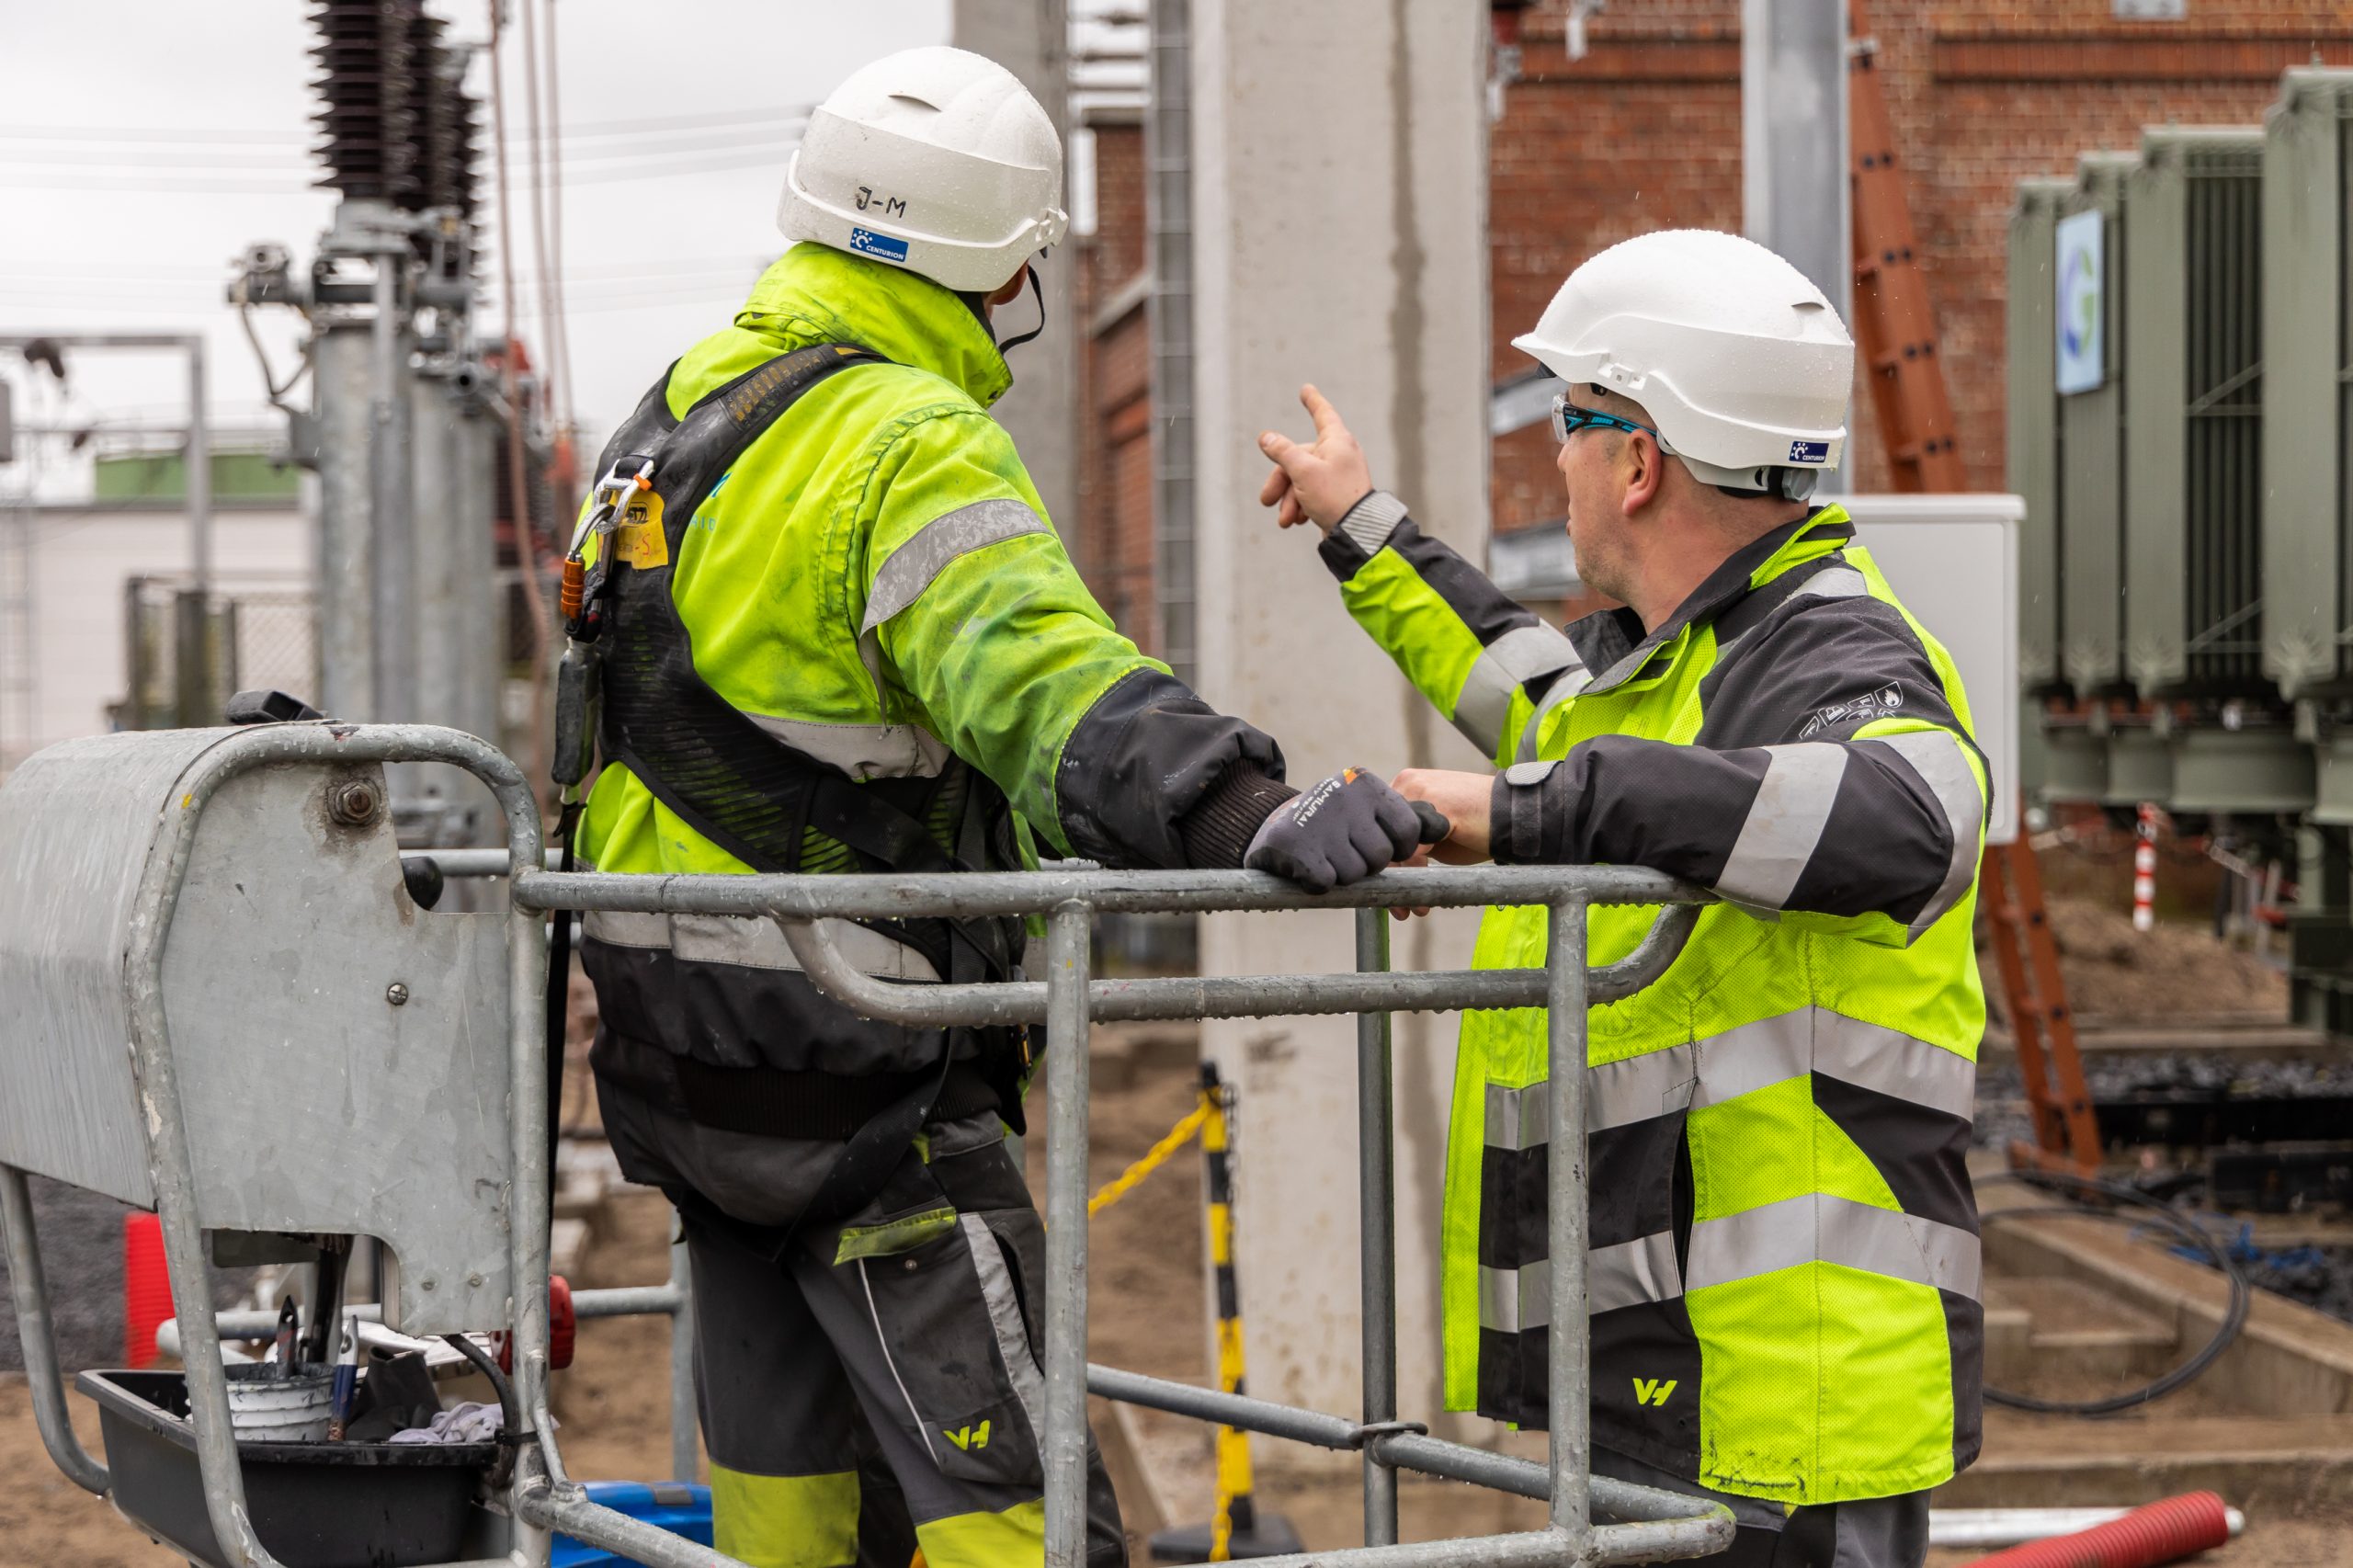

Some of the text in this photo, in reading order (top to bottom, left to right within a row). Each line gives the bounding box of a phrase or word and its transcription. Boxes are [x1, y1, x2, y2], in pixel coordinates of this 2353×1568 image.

[855, 186, 907, 219] J-M
[866, 244, 904, 260] CENTURION
[1297, 779, 1342, 827] SAMURAI
